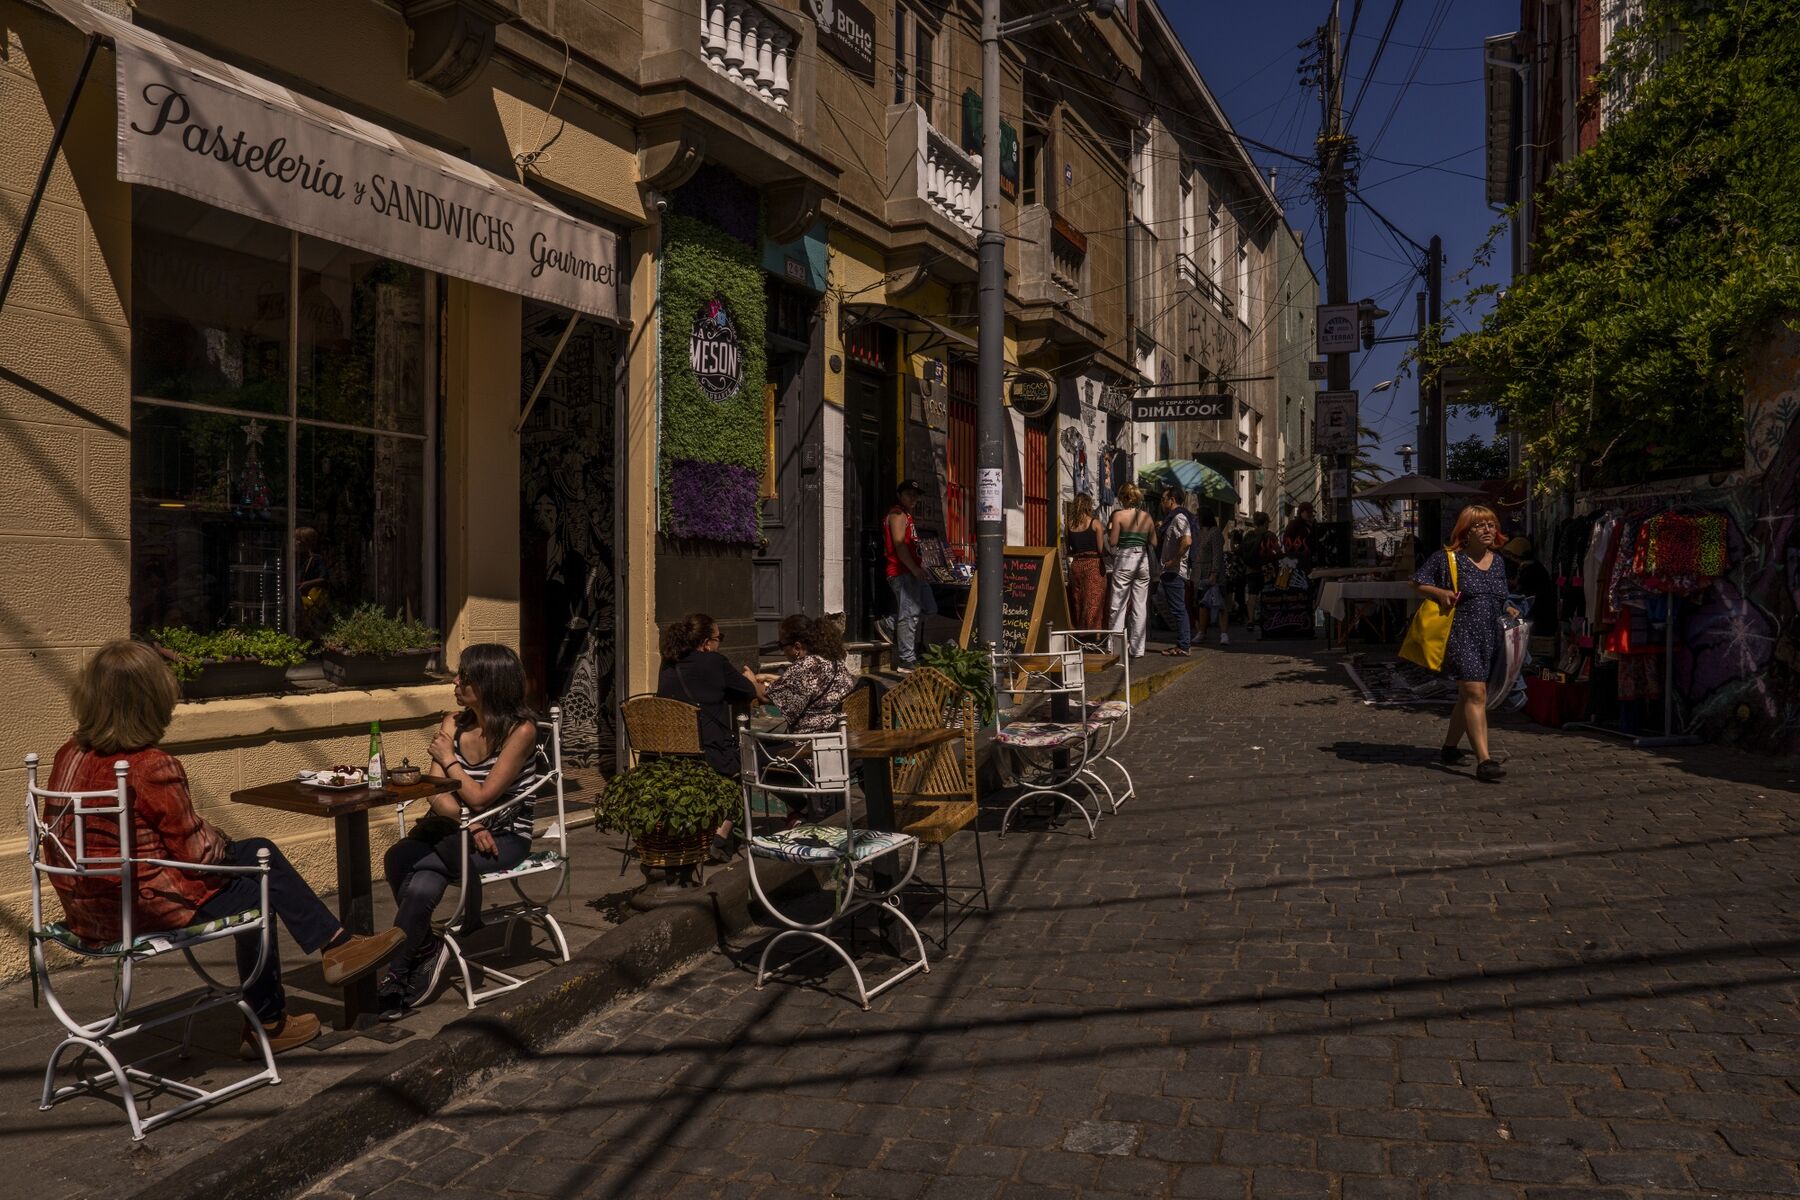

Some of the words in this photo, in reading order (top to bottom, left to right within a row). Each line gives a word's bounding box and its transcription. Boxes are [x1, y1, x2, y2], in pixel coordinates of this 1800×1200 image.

[837, 9, 873, 56] BOHO
[130, 82, 347, 200] Pastelería
[353, 181, 367, 206] y
[371, 174, 516, 256] SANDWICHS
[529, 231, 617, 289] Gourmet
[689, 337, 737, 379] MESON
[1137, 403, 1224, 418] DIMALOOK
